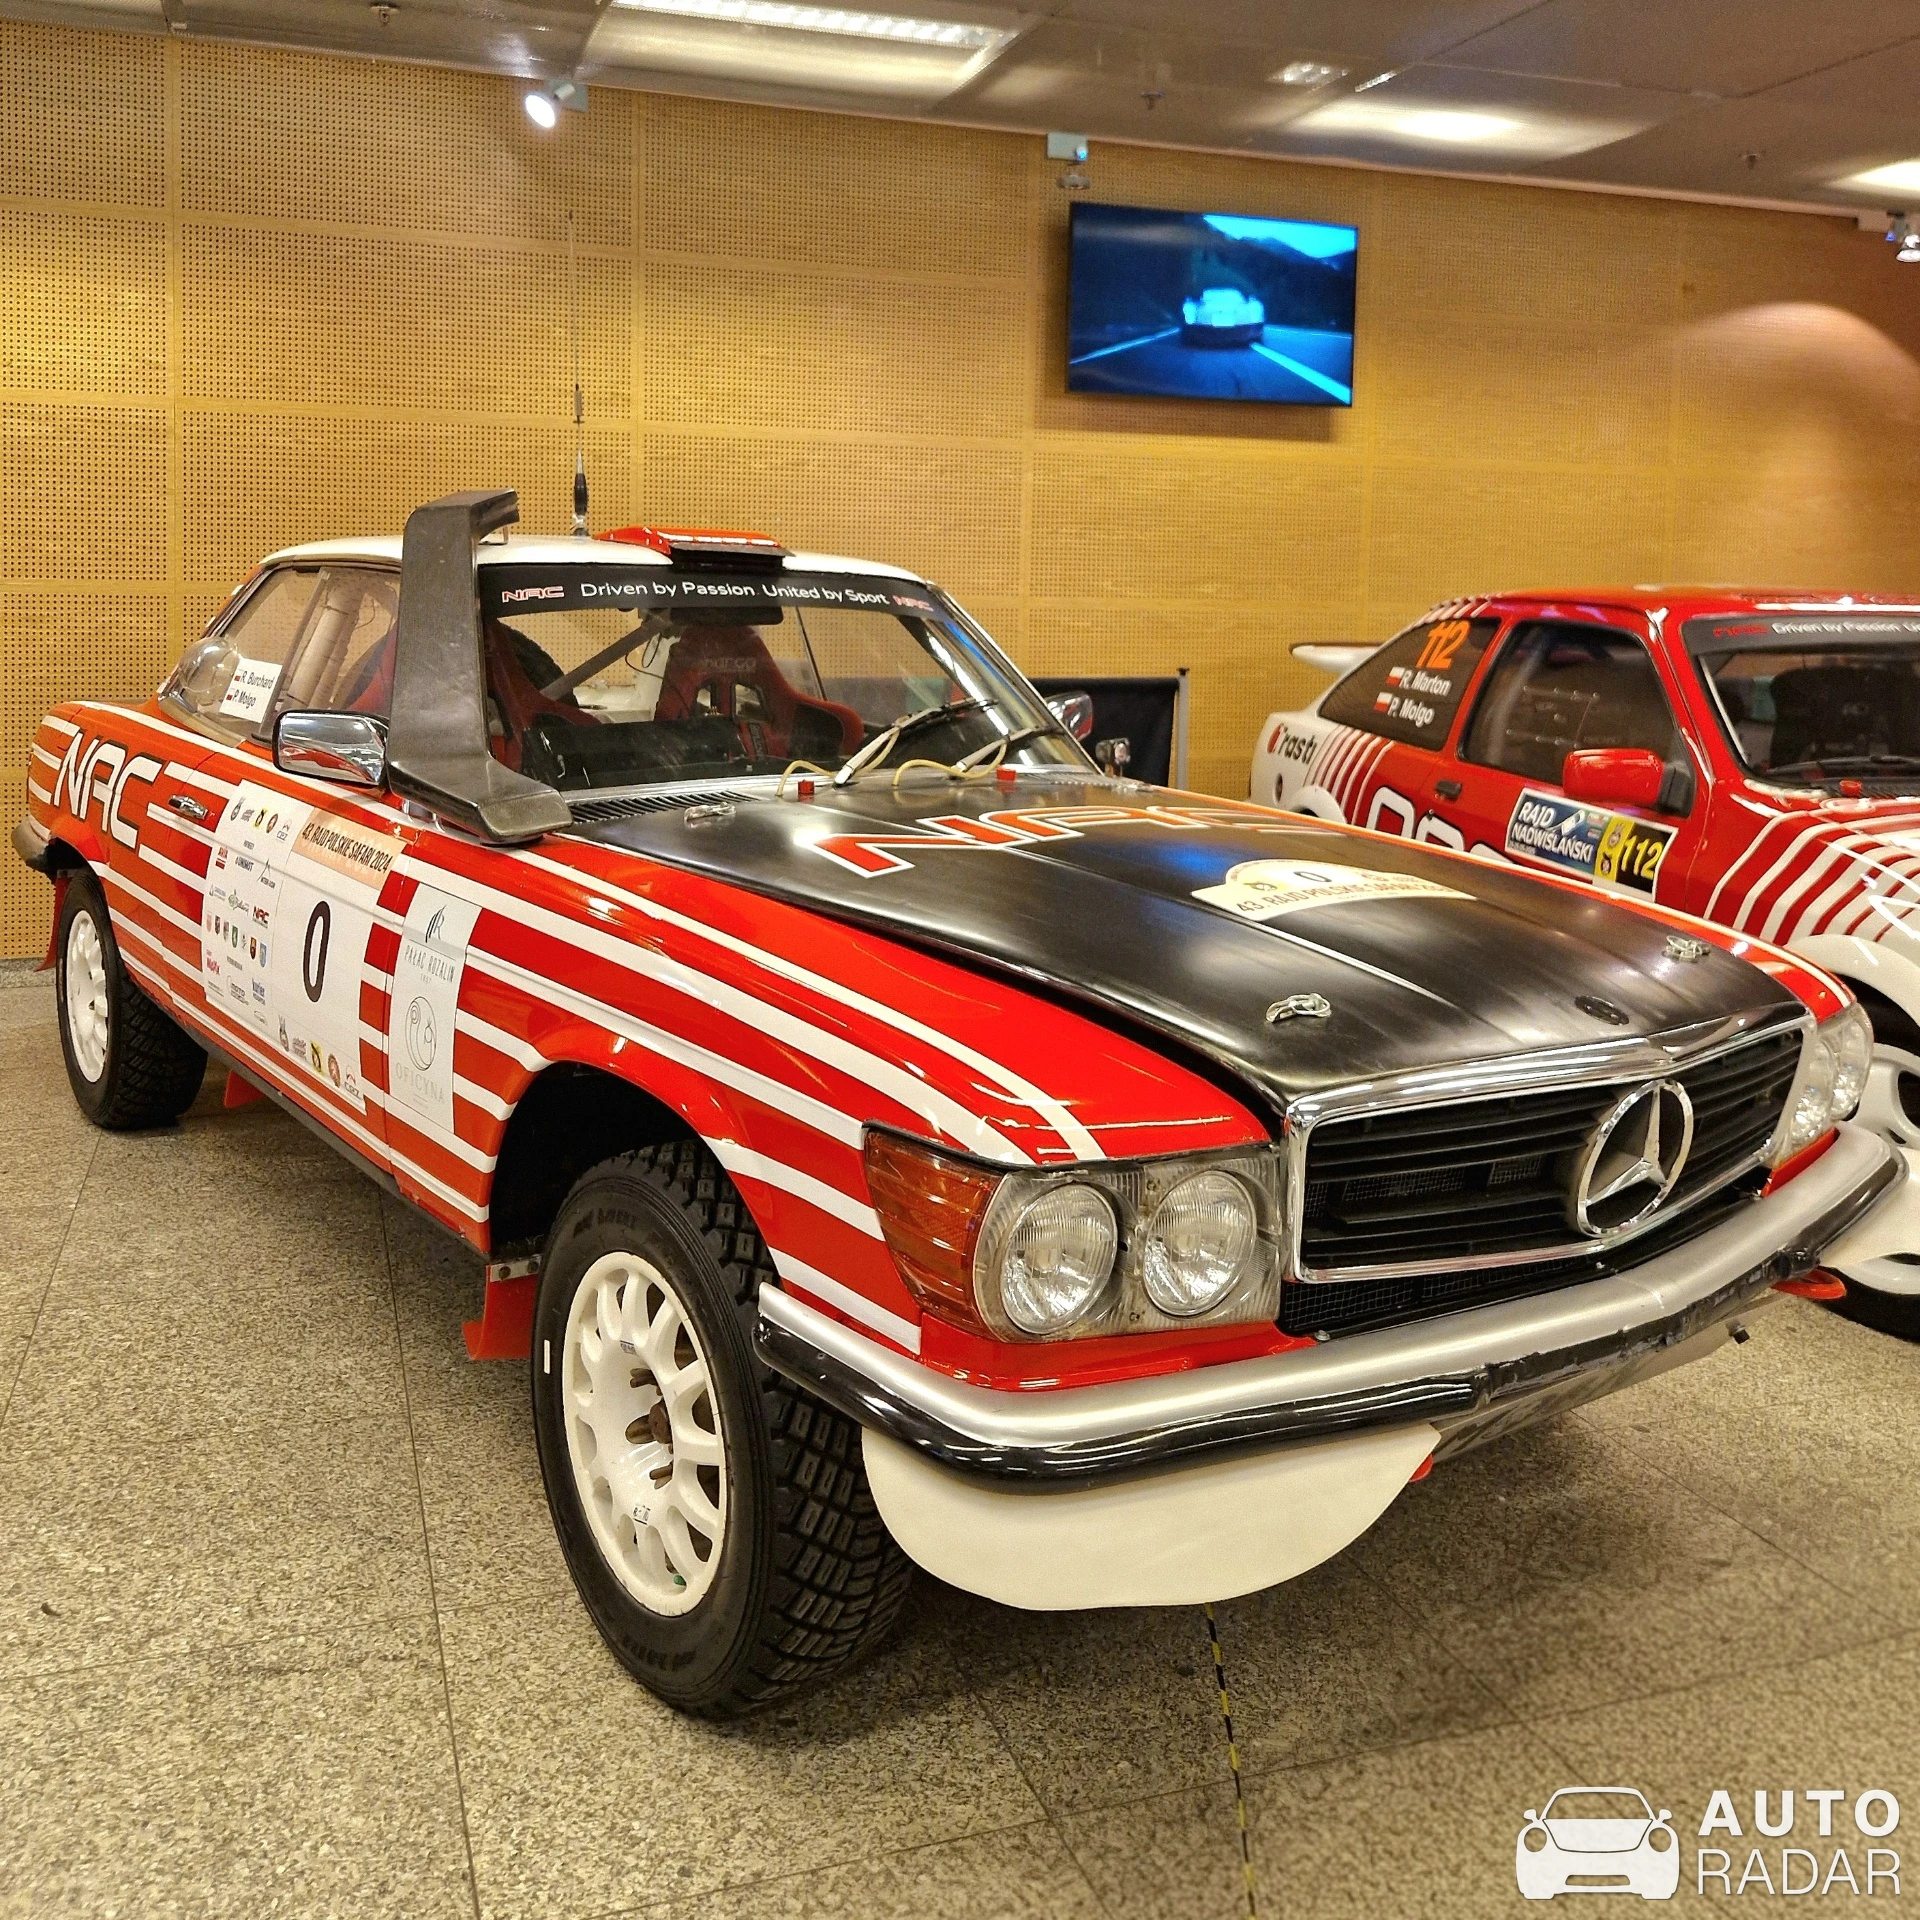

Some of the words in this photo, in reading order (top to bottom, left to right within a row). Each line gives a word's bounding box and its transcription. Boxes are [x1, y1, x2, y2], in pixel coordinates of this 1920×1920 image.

[581, 582, 648, 597] Driven
[652, 581, 677, 597] by
[682, 581, 755, 596] Passion
[762, 584, 820, 599] United
[822, 587, 843, 603] by
[844, 589, 890, 605] Sport
[1416, 620, 1471, 670] 112
[1772, 622, 1822, 634] Driven
[1821, 622, 1843, 634] by
[1843, 621, 1900, 633] Passion
[247, 672, 276, 690] Burchard
[1399, 669, 1413, 690] R.
[1411, 671, 1452, 697] Marton
[1388, 696, 1401, 718] P.
[1399, 698, 1436, 728] Molgo
[53, 731, 165, 850] NAC
[1518, 801, 1557, 828] RAJD
[311, 826, 331, 846] RAJD
[324, 832, 355, 857] POLSKIE
[349, 841, 376, 865] SAFARI
[370, 850, 394, 874] 2024
[1511, 823, 1594, 864] NADWIŚLAŃSKI
[1621, 835, 1663, 879] 112
[1294, 871, 1332, 882] 0
[1236, 899, 1271, 914] 43.
[1268, 889, 1310, 907] RAJD
[303, 901, 331, 1002] 0
[404, 944, 427, 970] PAŁAC
[428, 955, 456, 984] ROZALIN
[395, 1062, 444, 1104] OFICYNA
